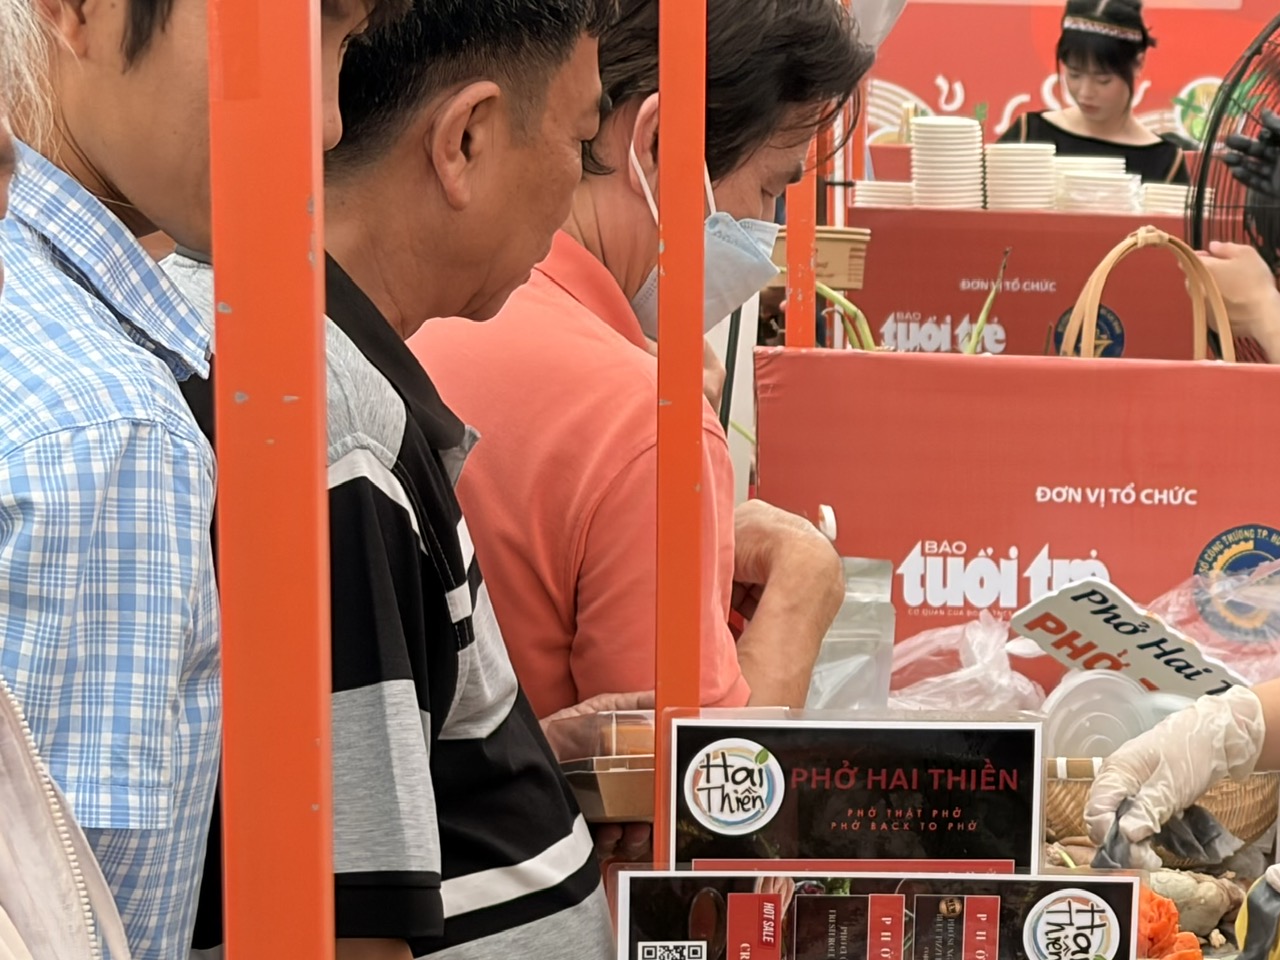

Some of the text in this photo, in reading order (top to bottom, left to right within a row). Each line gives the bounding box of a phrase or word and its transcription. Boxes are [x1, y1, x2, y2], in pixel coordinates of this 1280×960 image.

[960, 276, 1057, 292] ĐƠN Ị TỔ CHỨC
[1035, 479, 1198, 508] ĐƠN VỊ TỔ CHỨC
[896, 540, 1018, 609] tuổi
[1024, 611, 1131, 672] PHỞ
[1070, 588, 1212, 681] Phở Hai
[700, 751, 765, 789] Hai
[790, 758, 1019, 791] PHỞ HAI THIỀN
[697, 784, 764, 814] Thiền
[847, 806, 877, 818] PHỞ
[932, 806, 963, 818] PHỞ
[831, 819, 978, 831] PHỞ BACK TO PHỞ
[762, 902, 775, 944] HOT SALE
[880, 917, 894, 959] PHỞ
[975, 913, 989, 960] PHỞ
